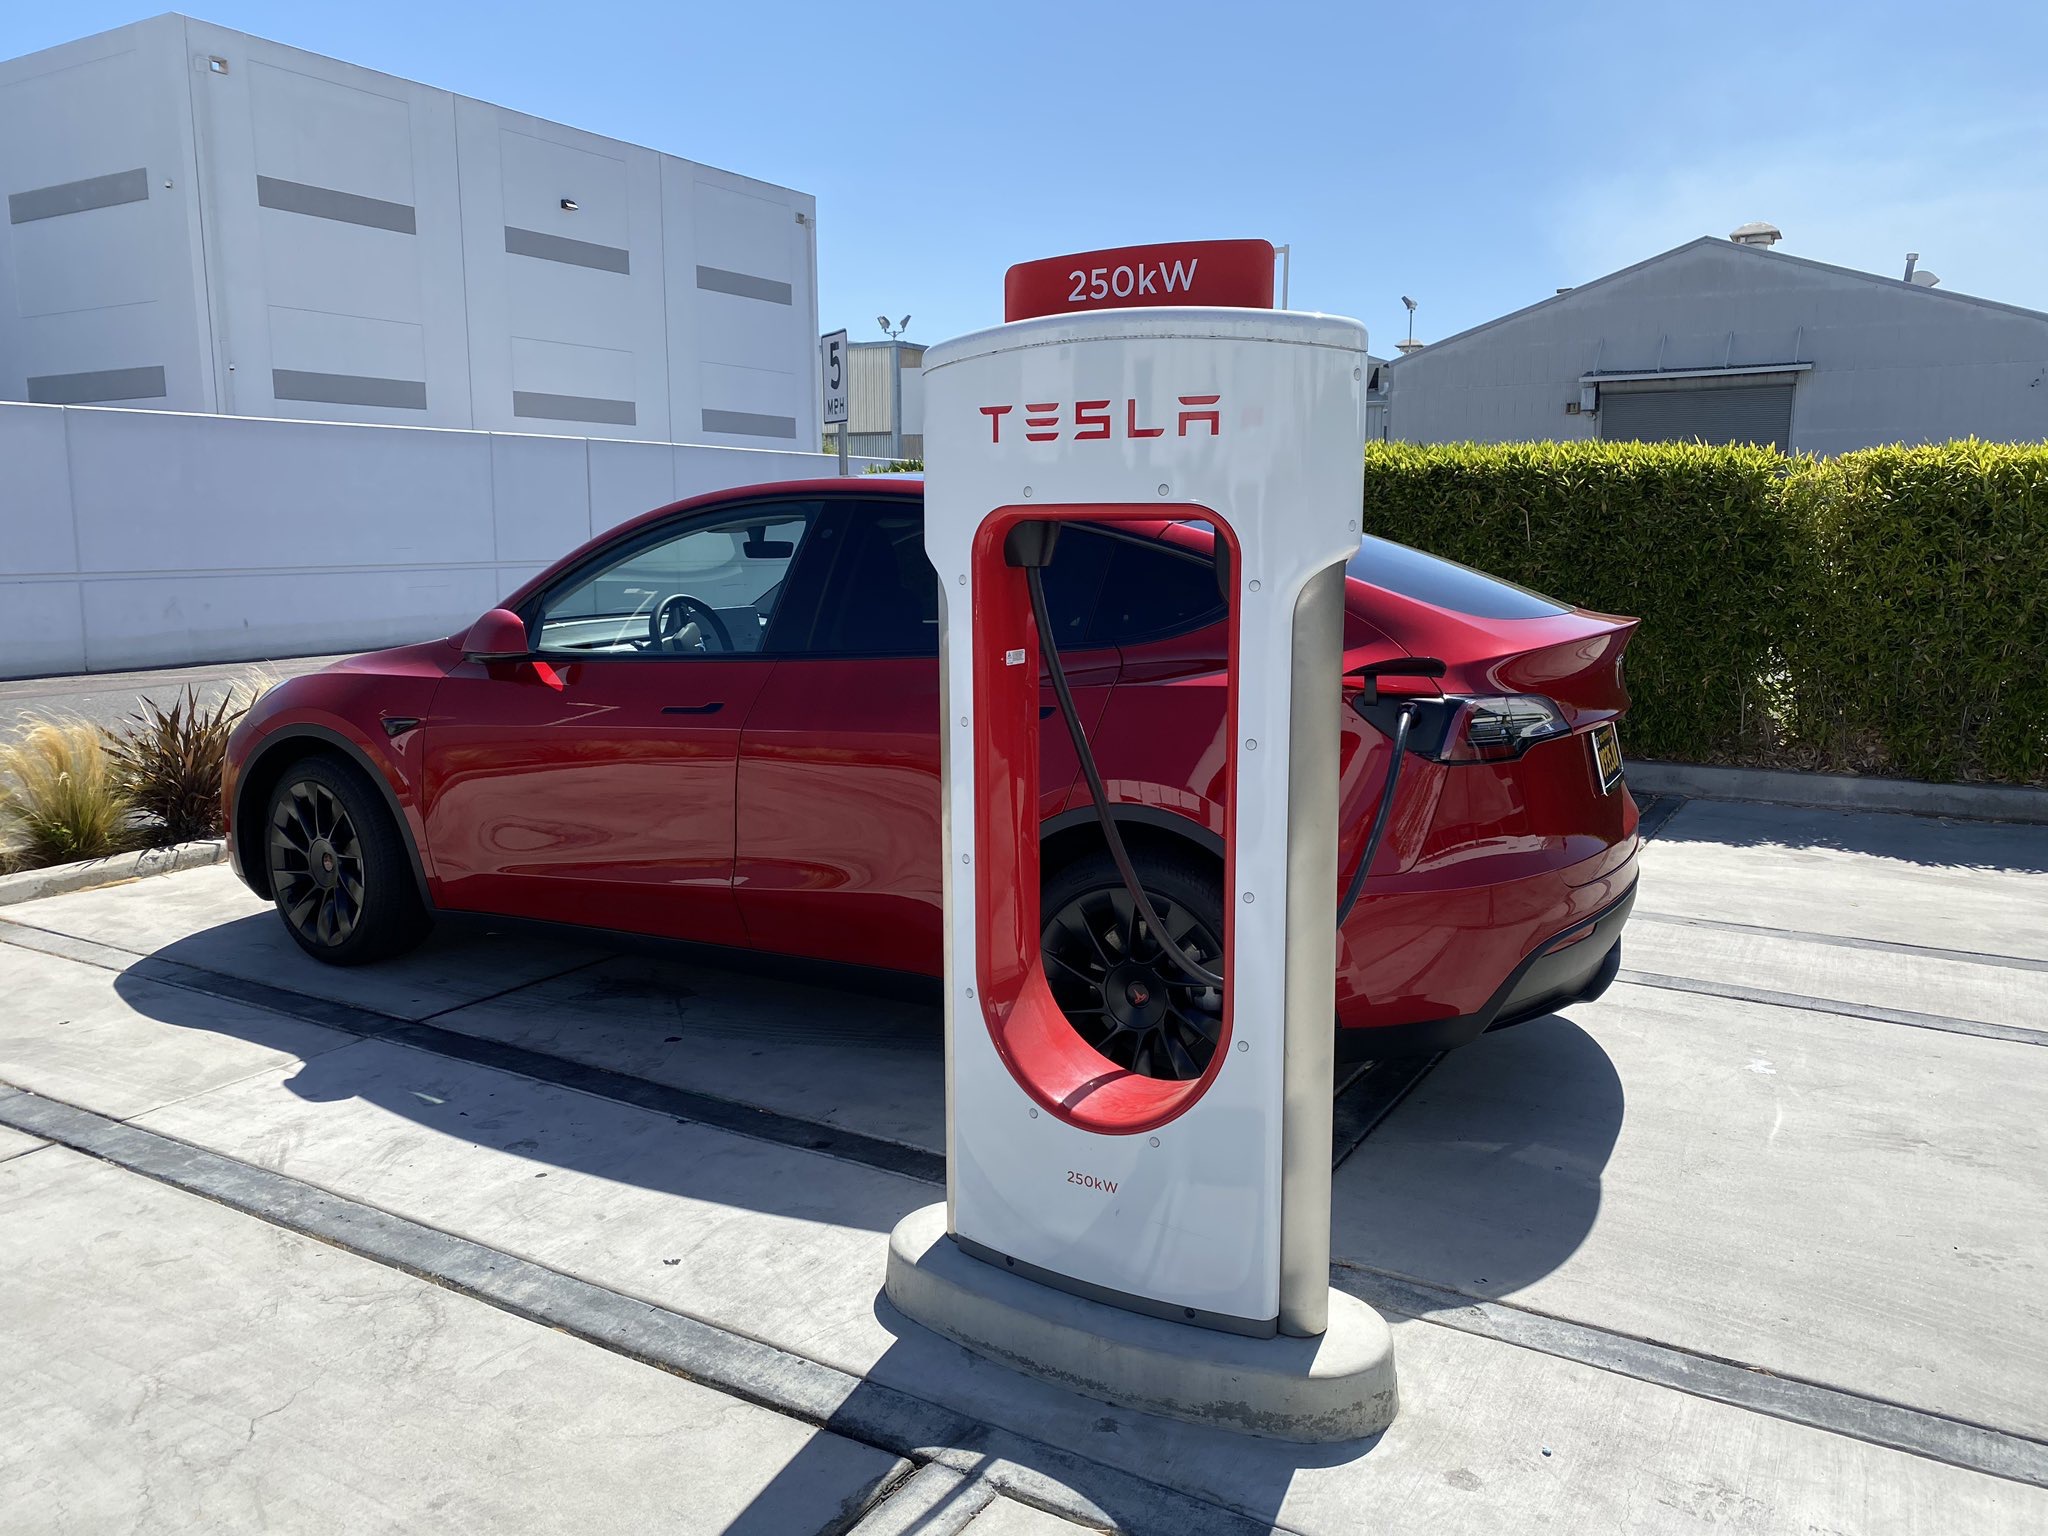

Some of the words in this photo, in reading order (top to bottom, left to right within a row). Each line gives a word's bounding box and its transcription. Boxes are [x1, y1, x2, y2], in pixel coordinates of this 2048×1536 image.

[1068, 258, 1198, 302] 250kW
[829, 341, 841, 390] 5
[827, 397, 845, 415] MPH
[979, 395, 1221, 443] TESLA
[1067, 1170, 1118, 1194] 250kW
